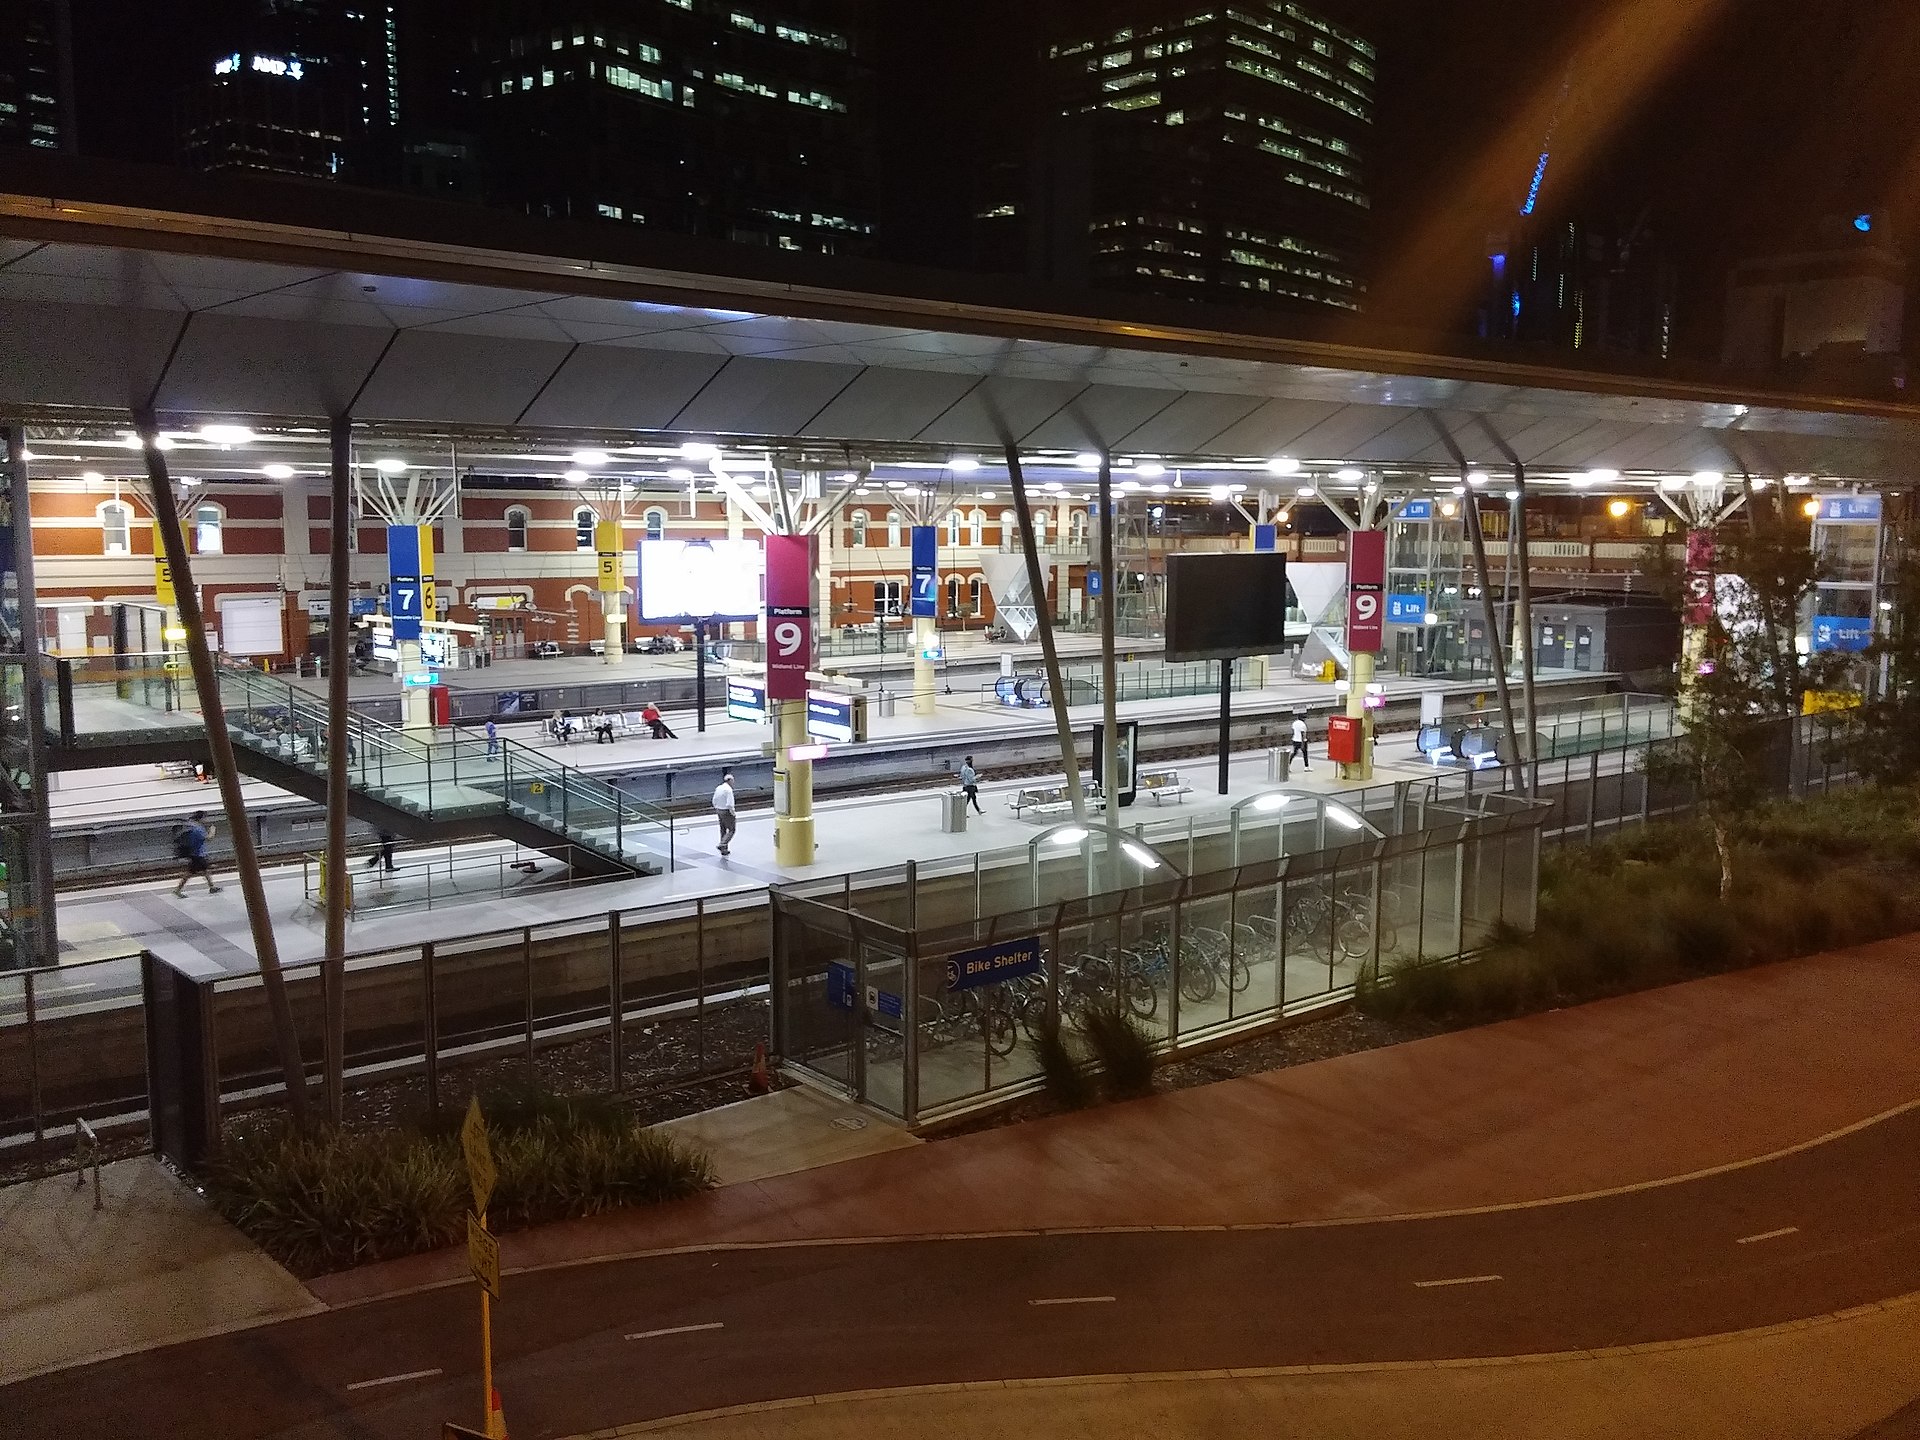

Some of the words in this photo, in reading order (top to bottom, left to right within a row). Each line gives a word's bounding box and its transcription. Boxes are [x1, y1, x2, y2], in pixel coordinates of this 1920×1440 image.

[1411, 506, 1424, 514] Lift
[604, 561, 613, 573] 5
[916, 574, 931, 594] 7
[397, 589, 414, 610] 7
[425, 587, 433, 609] 6
[1355, 595, 1377, 621] 9
[1406, 605, 1420, 613] Lift
[774, 622, 802, 657] 9
[535, 784, 541, 792] 2
[966, 961, 991, 975] Bike
[994, 950, 1033, 968] Shelter
